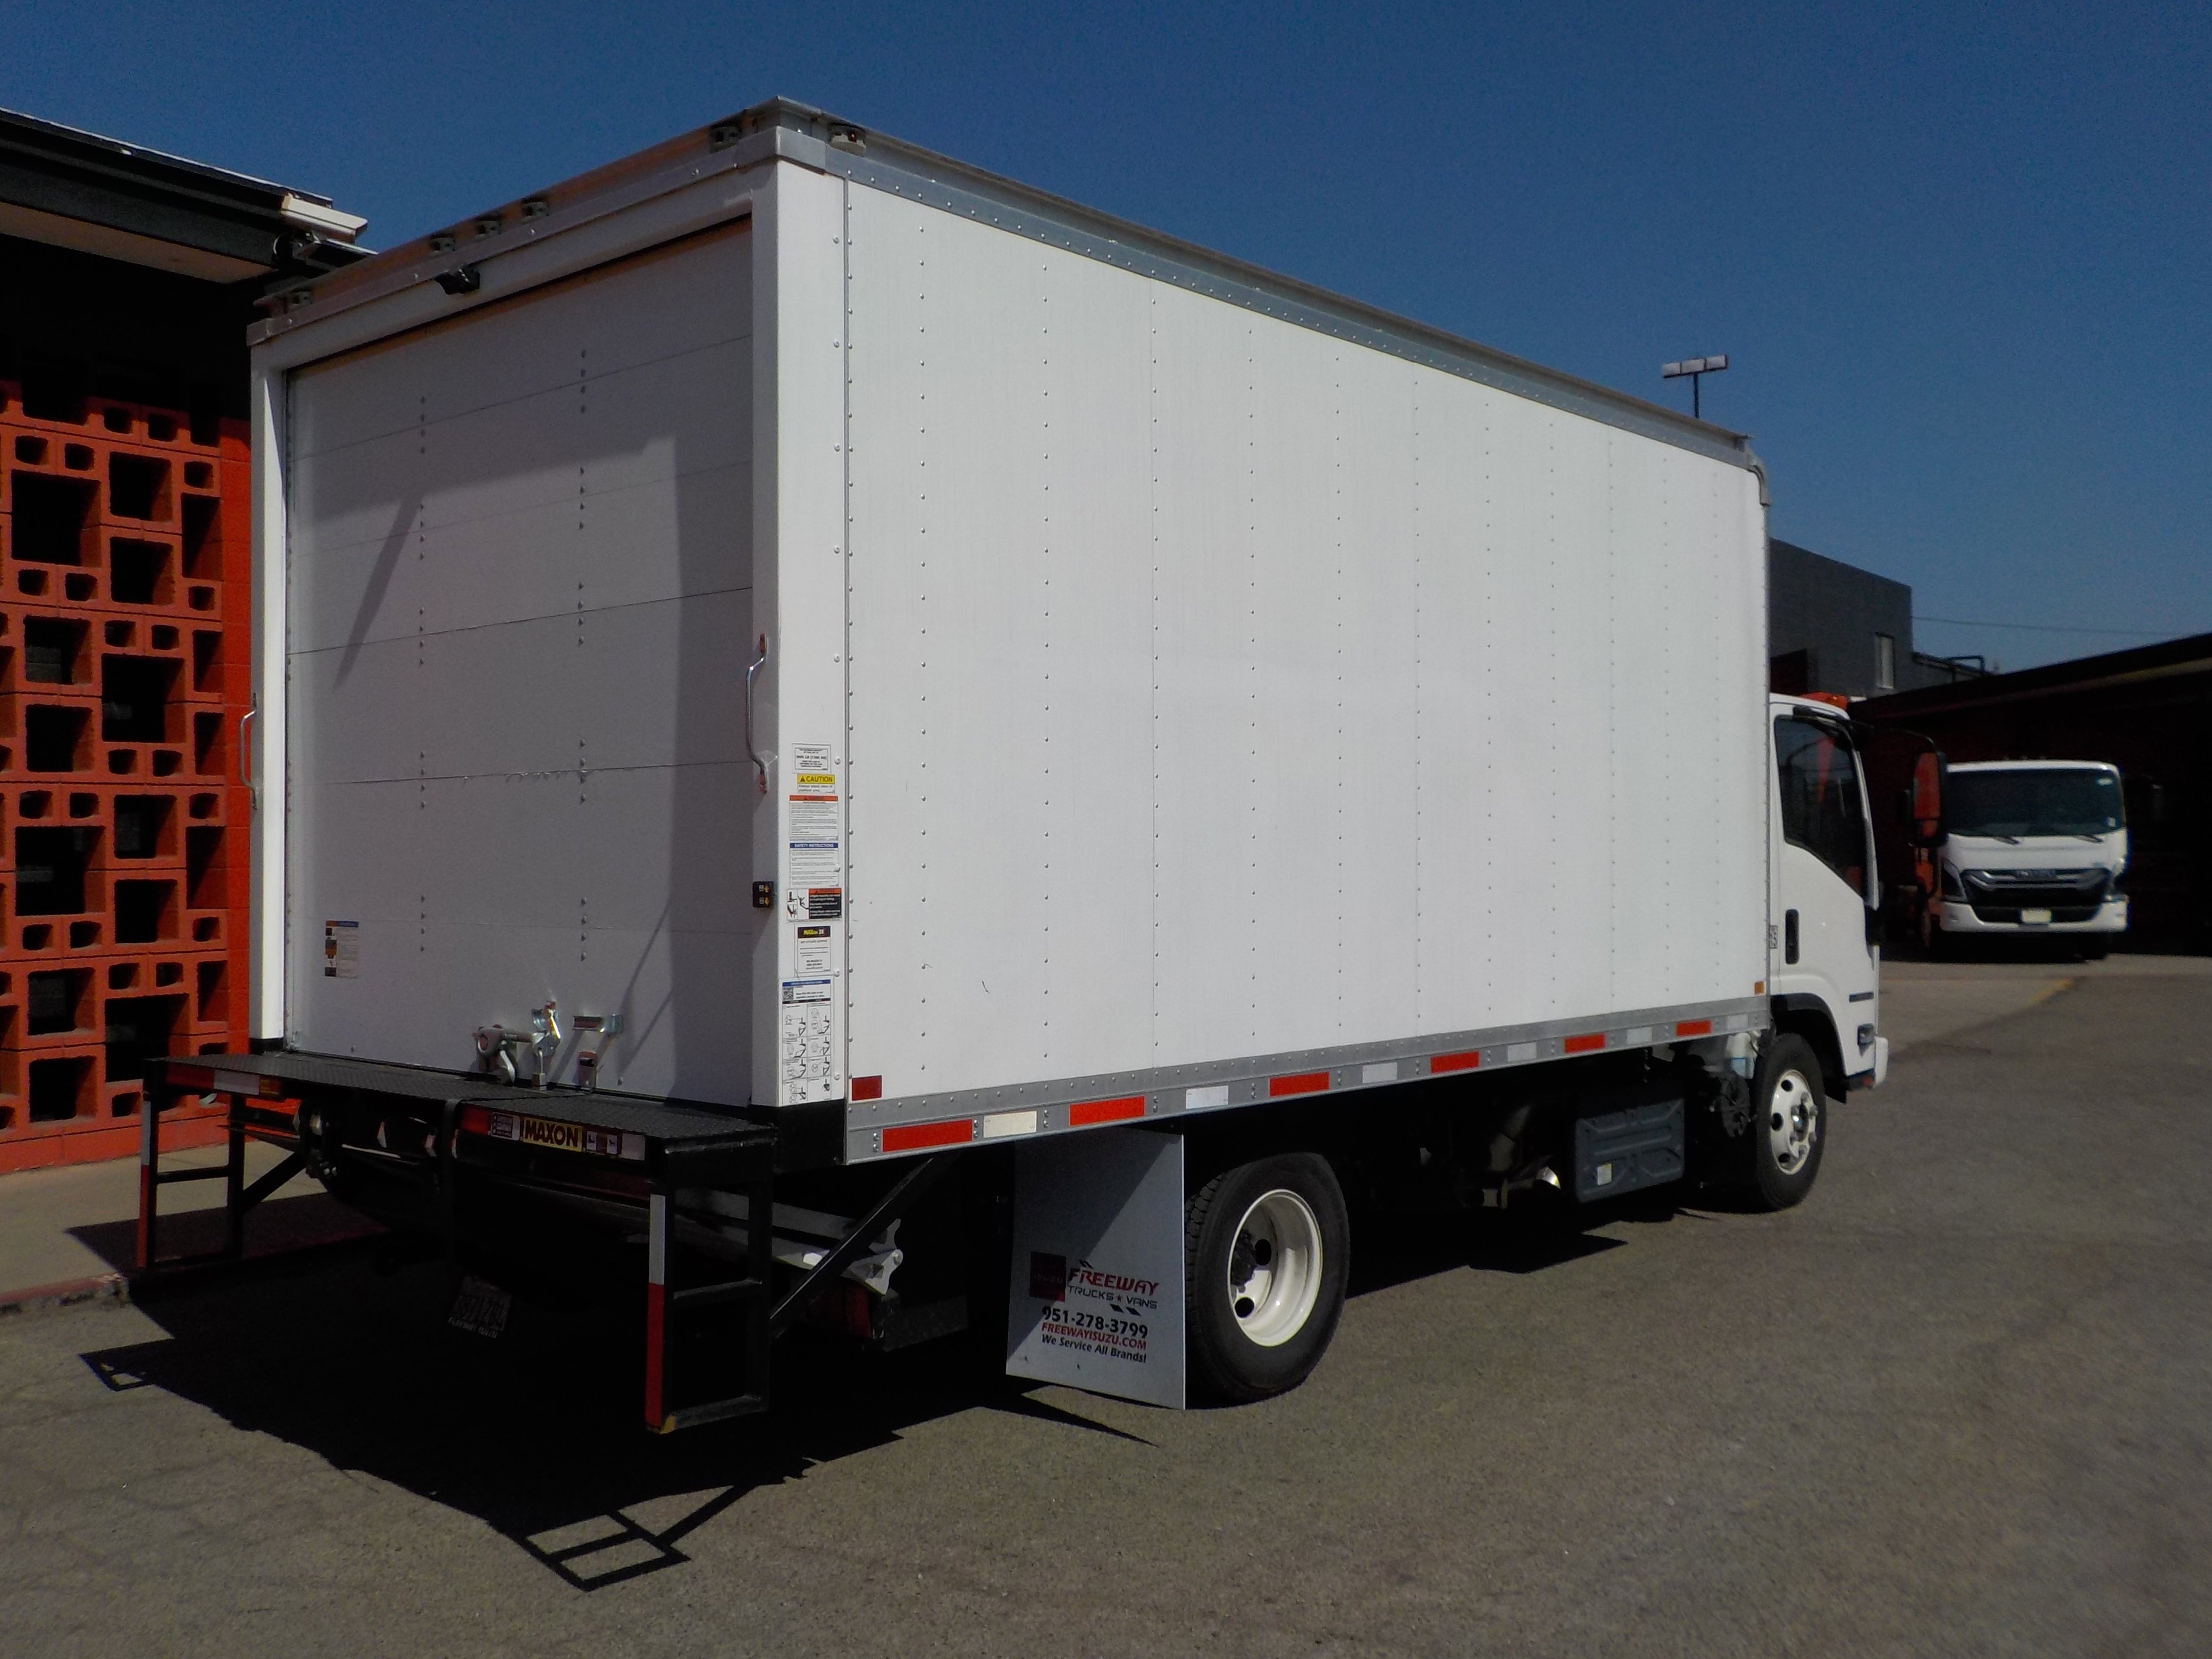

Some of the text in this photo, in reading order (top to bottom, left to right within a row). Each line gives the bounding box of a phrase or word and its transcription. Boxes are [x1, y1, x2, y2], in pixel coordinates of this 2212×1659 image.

[524, 1120, 579, 1147] MAXON
[1068, 1268, 1159, 1296] FREEWAY
[1068, 1285, 1158, 1309] TRUCKS VANS
[1042, 1305, 1149, 1339] 951-278-3799
[1041, 1322, 1147, 1351] FREEWAYISUZU.COM
[1041, 1334, 1147, 1363] We Service All Brands!
